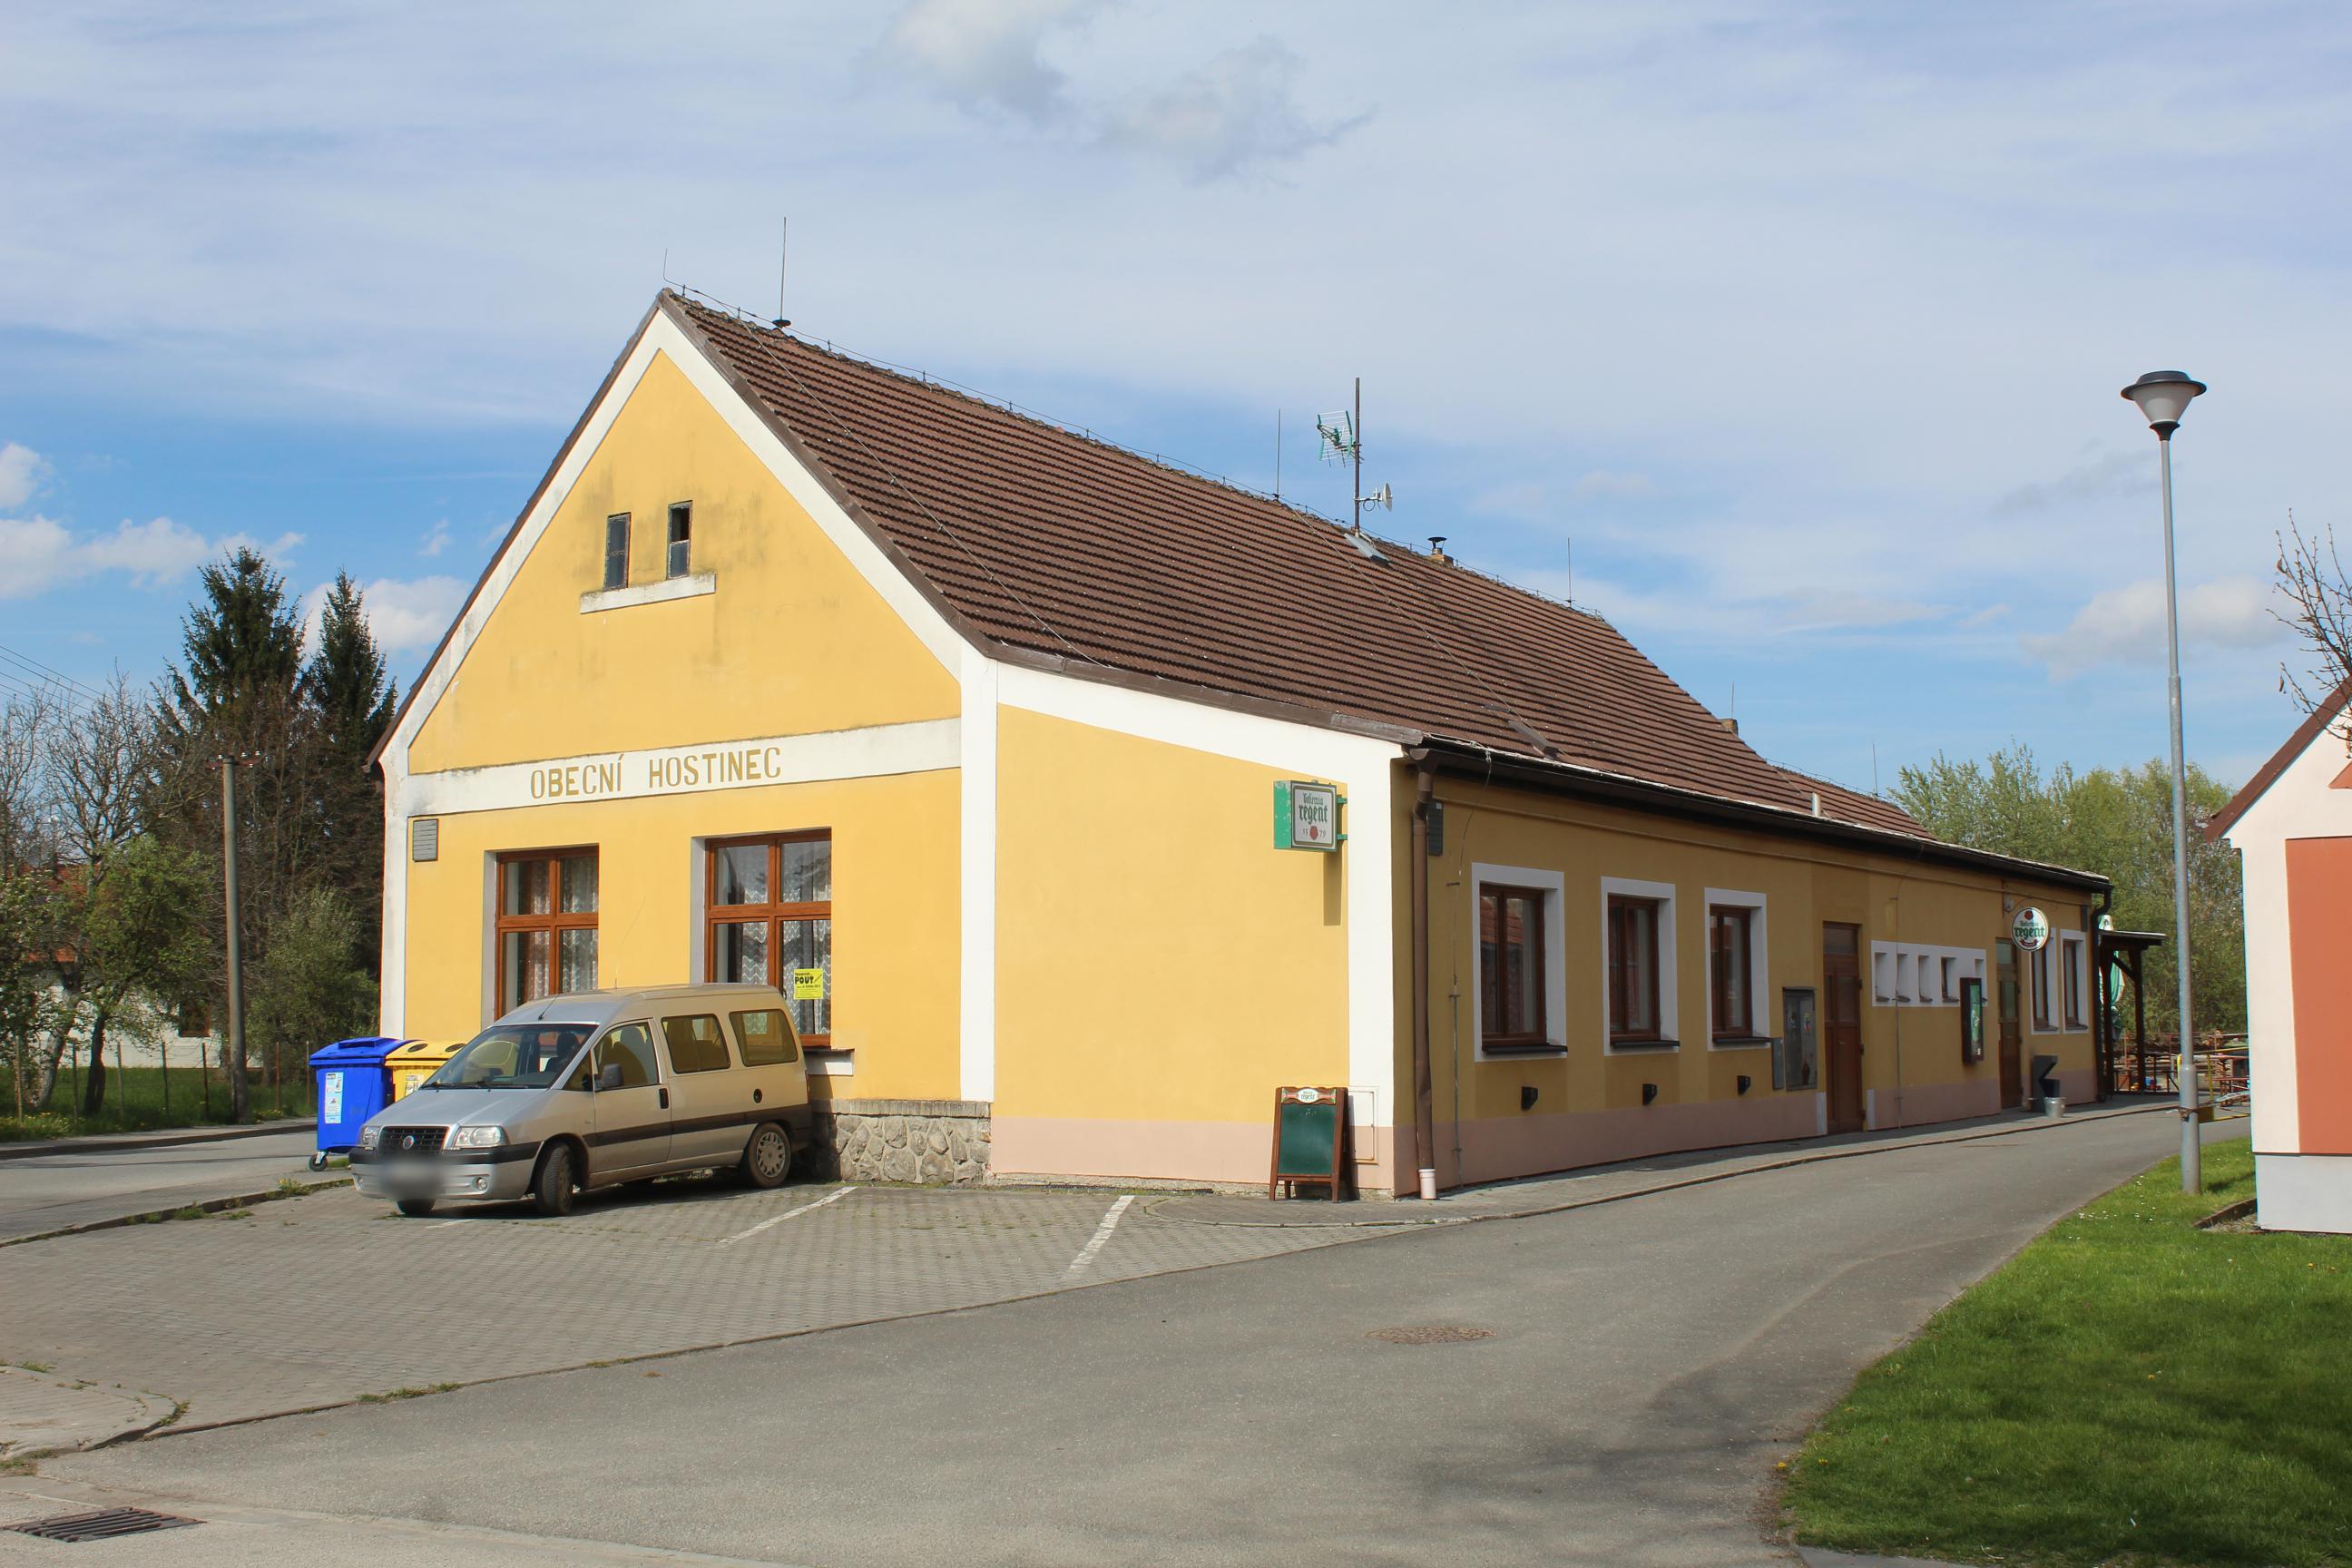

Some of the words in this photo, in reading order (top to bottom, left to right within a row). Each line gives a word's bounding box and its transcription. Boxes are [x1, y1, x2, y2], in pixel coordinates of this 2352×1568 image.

[530, 754, 625, 799] OBECNÍ
[649, 747, 781, 789] HOSTINEC
[1298, 804, 1328, 825] regent
[2014, 926, 2045, 940] regent
